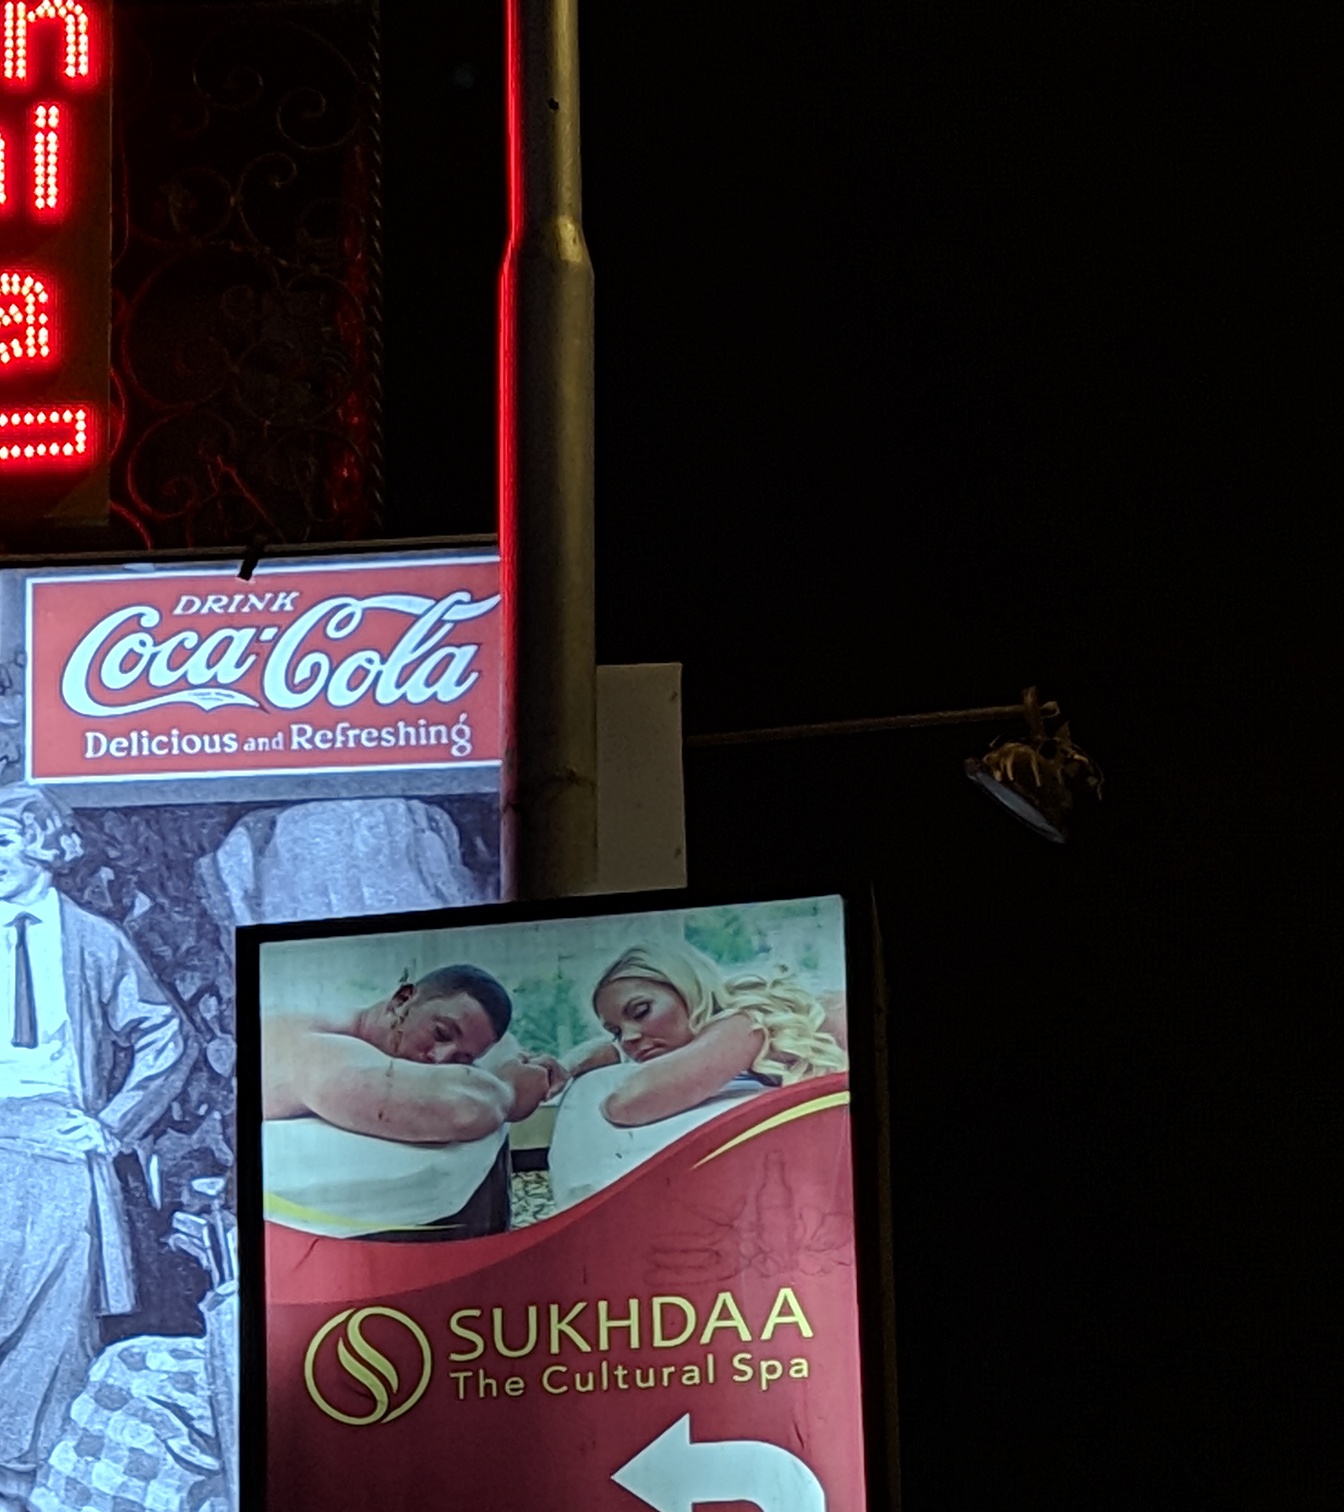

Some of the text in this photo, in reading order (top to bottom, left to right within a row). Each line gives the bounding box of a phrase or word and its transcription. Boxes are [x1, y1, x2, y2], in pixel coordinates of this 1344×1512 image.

[173, 591, 300, 616] DRINK
[61, 590, 501, 717] Coca-Cola
[84, 712, 473, 759] Delicious and Refreshing
[449, 1286, 815, 1363] SUKHDAA
[449, 1352, 811, 1400] The Cultural Spa
